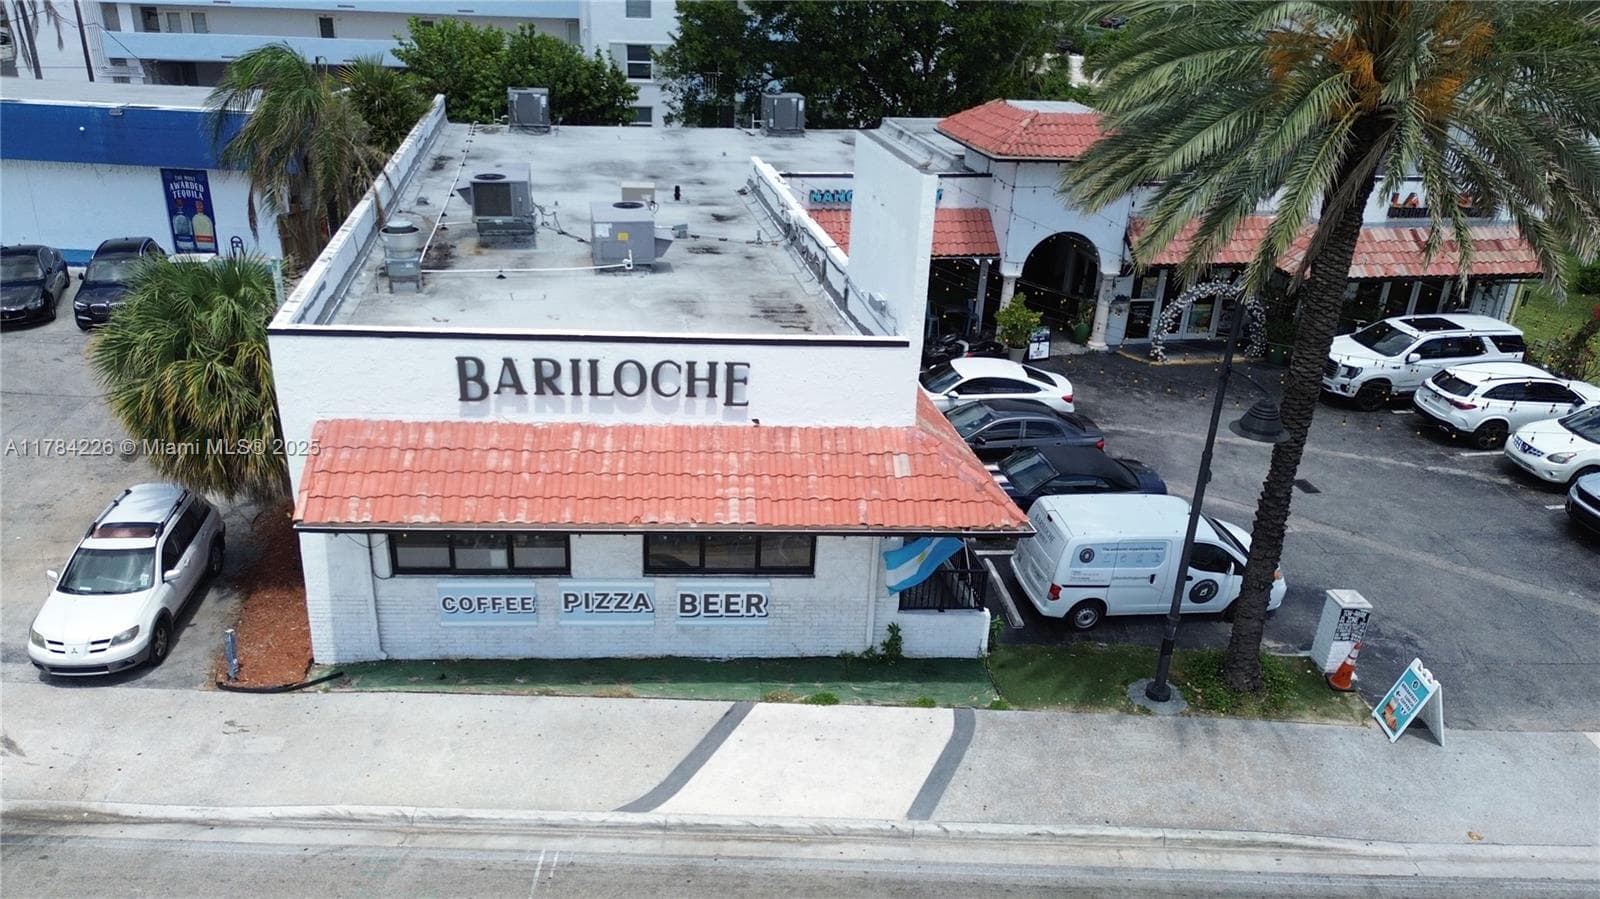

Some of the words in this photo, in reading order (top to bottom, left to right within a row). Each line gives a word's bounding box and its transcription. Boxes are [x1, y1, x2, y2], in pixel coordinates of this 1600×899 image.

[169, 181, 205, 193] AWARDED
[172, 189, 204, 200] TEQUILA
[455, 356, 751, 407] BARILOCHE
[441, 595, 536, 614] COFFEE
[563, 591, 654, 614] PIZZA
[678, 593, 768, 618] BEER
